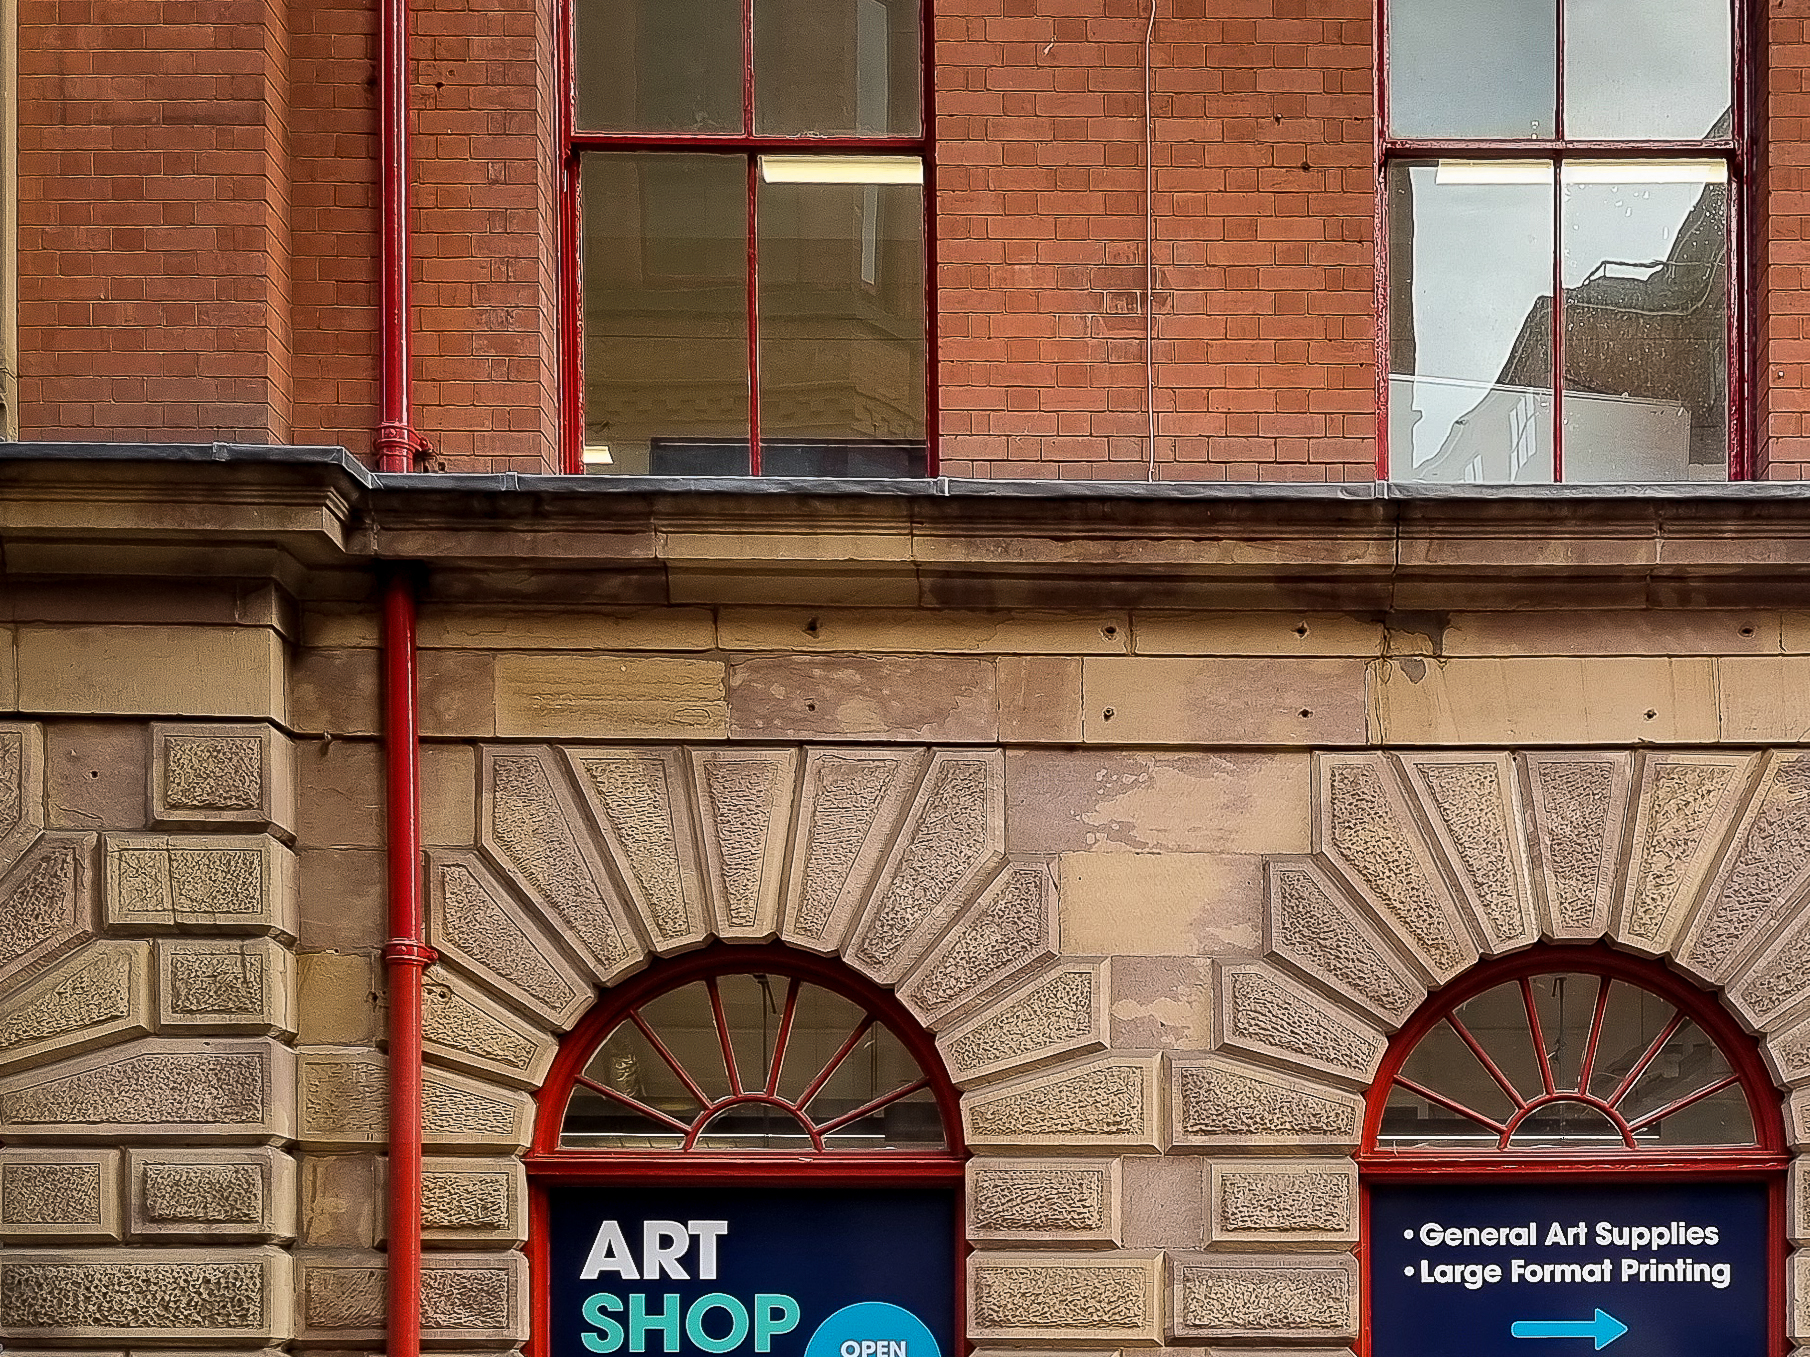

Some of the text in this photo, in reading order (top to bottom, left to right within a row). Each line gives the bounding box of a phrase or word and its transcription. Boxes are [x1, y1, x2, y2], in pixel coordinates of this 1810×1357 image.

[579, 1220, 729, 1280] ART
[1419, 1222, 1720, 1251] General Art Supplies
[1420, 1259, 1731, 1290] Large Format Printing
[581, 1292, 802, 1354] SHOP
